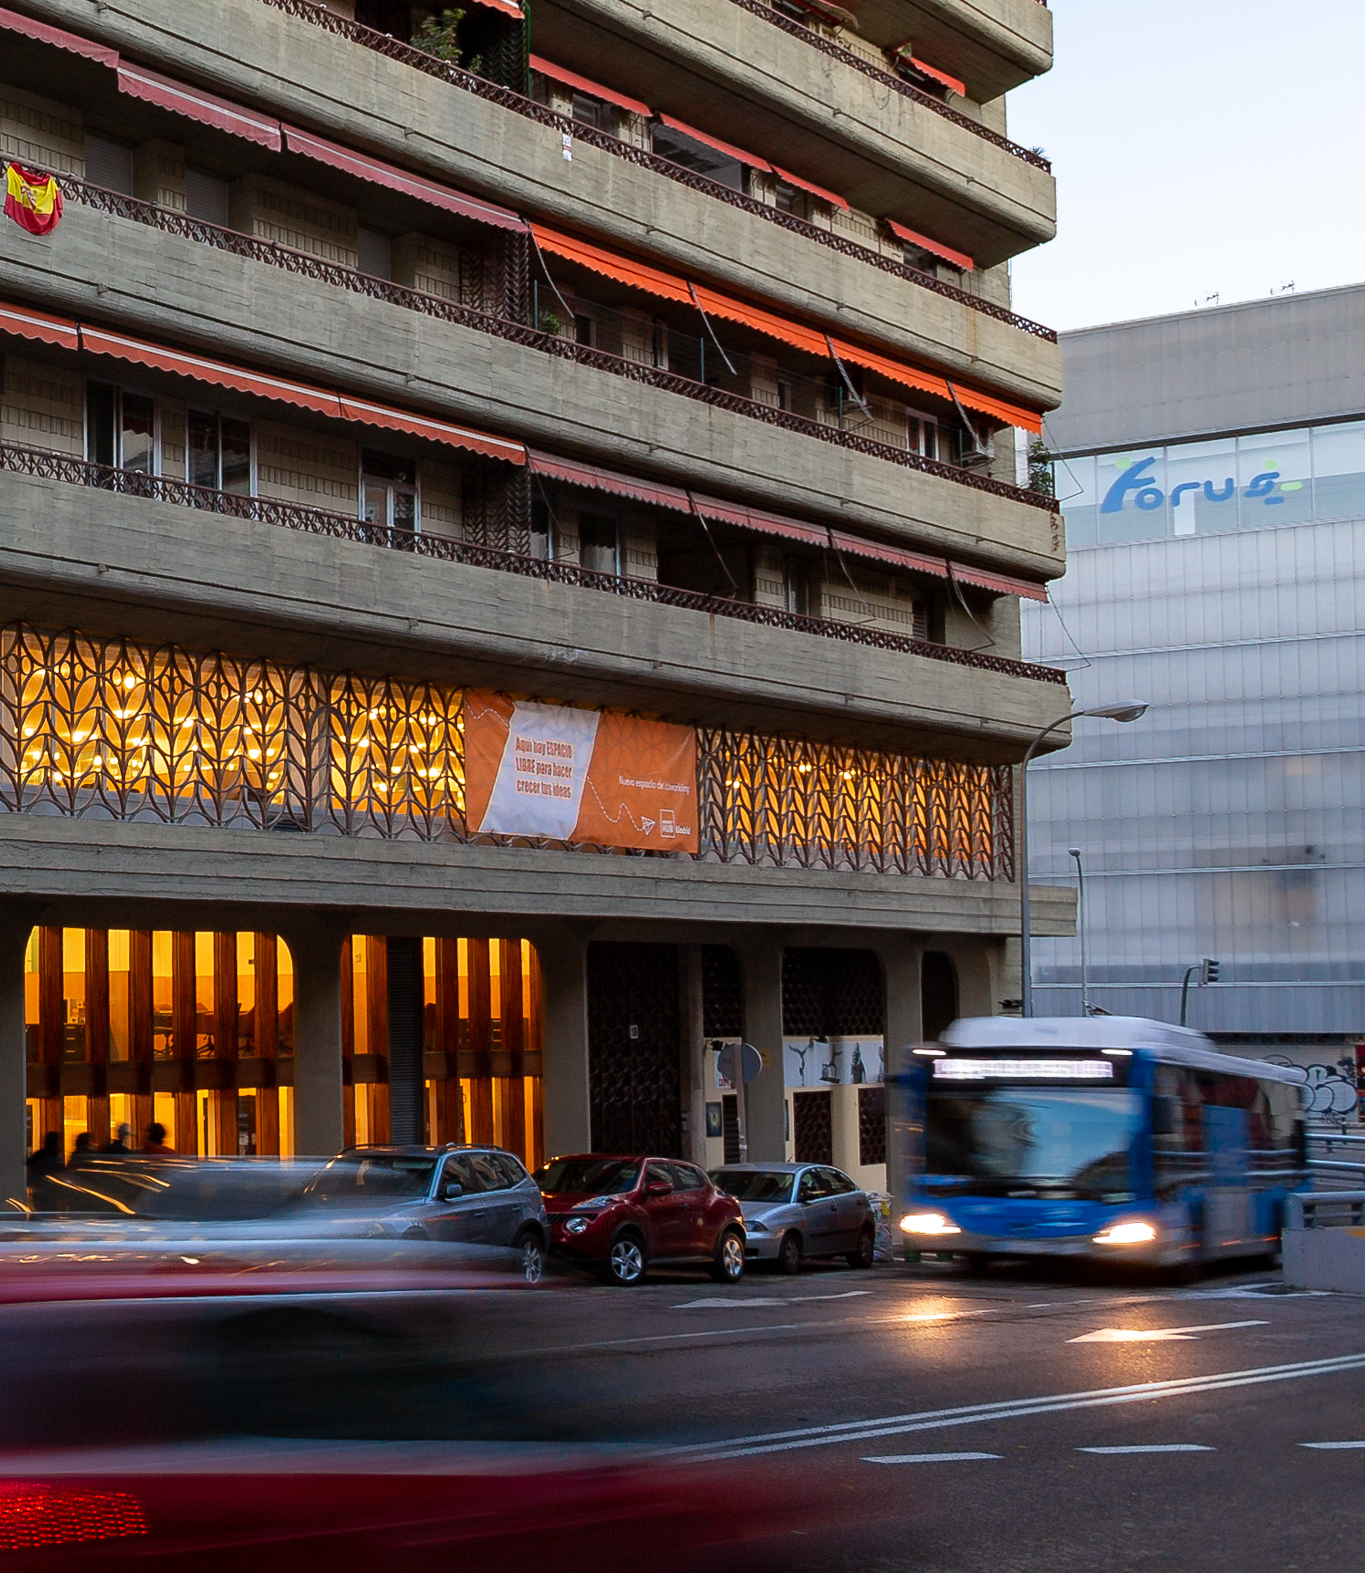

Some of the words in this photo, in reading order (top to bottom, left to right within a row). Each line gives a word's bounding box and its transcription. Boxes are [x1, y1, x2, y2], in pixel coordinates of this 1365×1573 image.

[1101, 456, 1284, 513] Forus
[533, 739, 546, 756] hay
[547, 741, 572, 759] ESPACIO
[516, 757, 536, 774] LIBRE
[536, 762, 552, 776] para
[553, 762, 572, 778] hacer
[517, 779, 540, 794] crecer
[541, 781, 552, 796] tus
[553, 782, 571, 798] ideas
